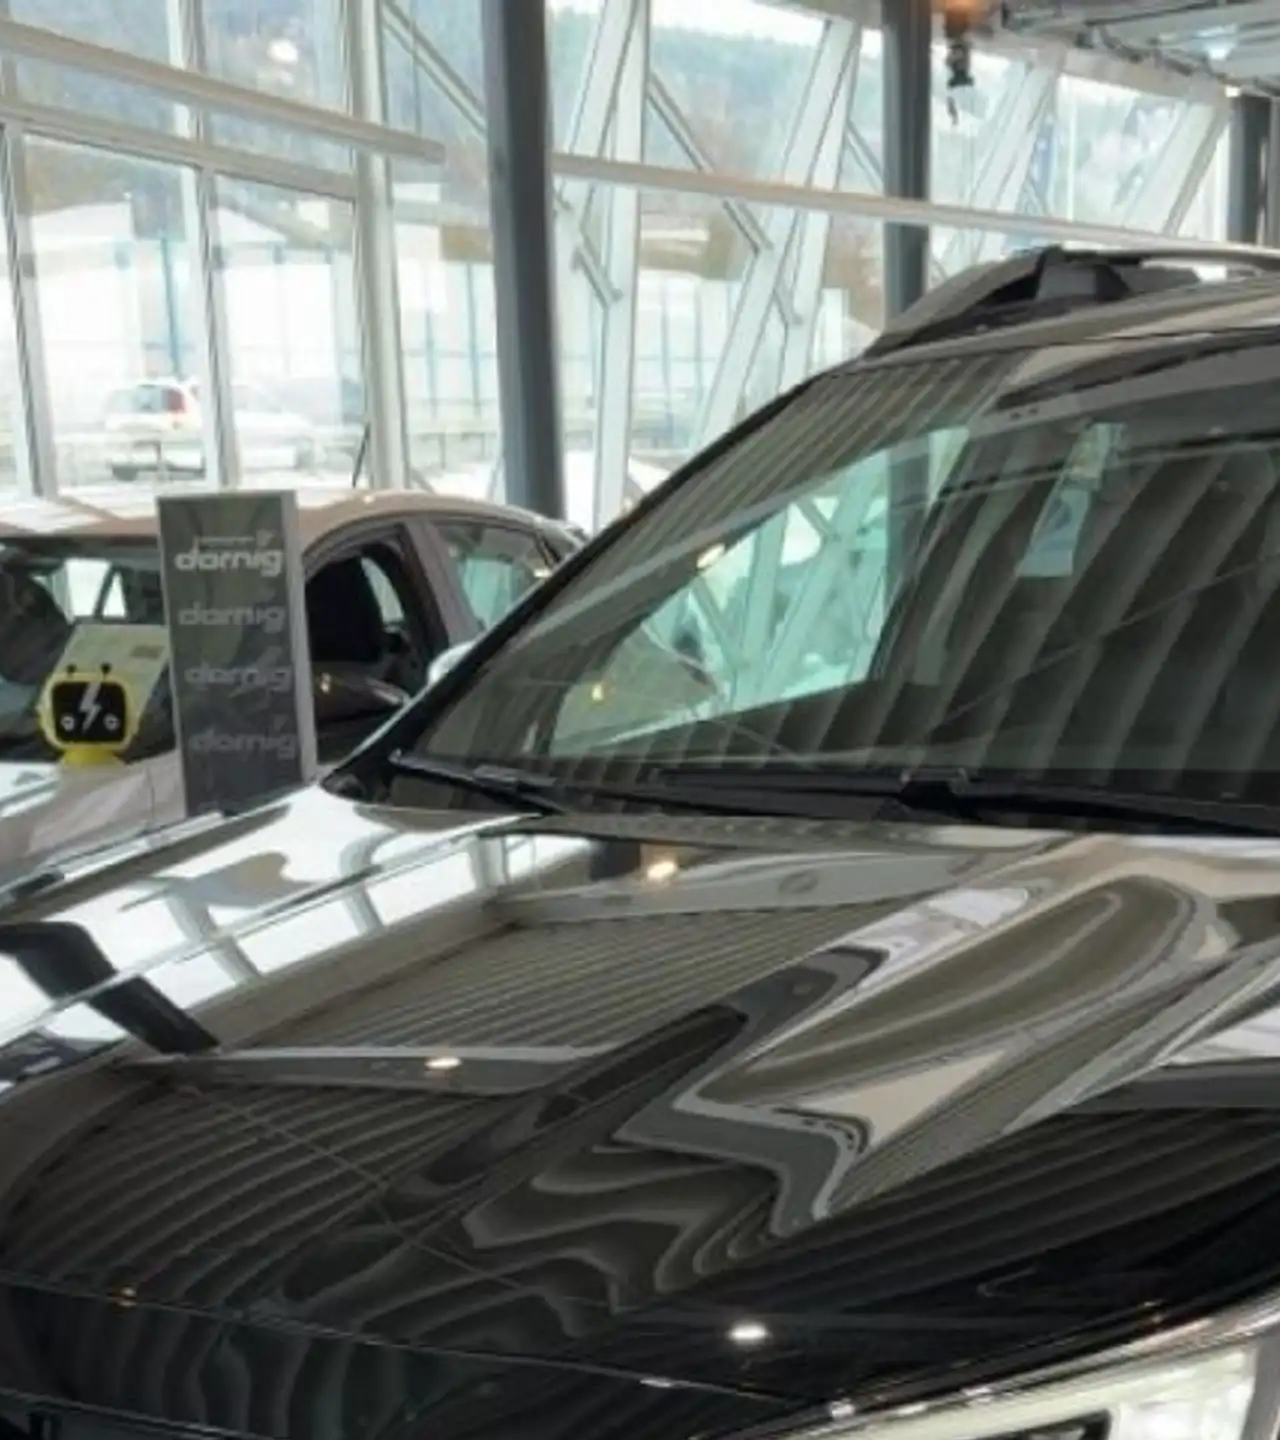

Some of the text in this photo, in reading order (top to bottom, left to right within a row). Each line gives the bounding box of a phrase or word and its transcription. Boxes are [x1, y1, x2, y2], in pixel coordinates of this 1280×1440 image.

[175, 529, 283, 577] dornig
[178, 594, 285, 634] dornig
[188, 717, 296, 760] dornig
